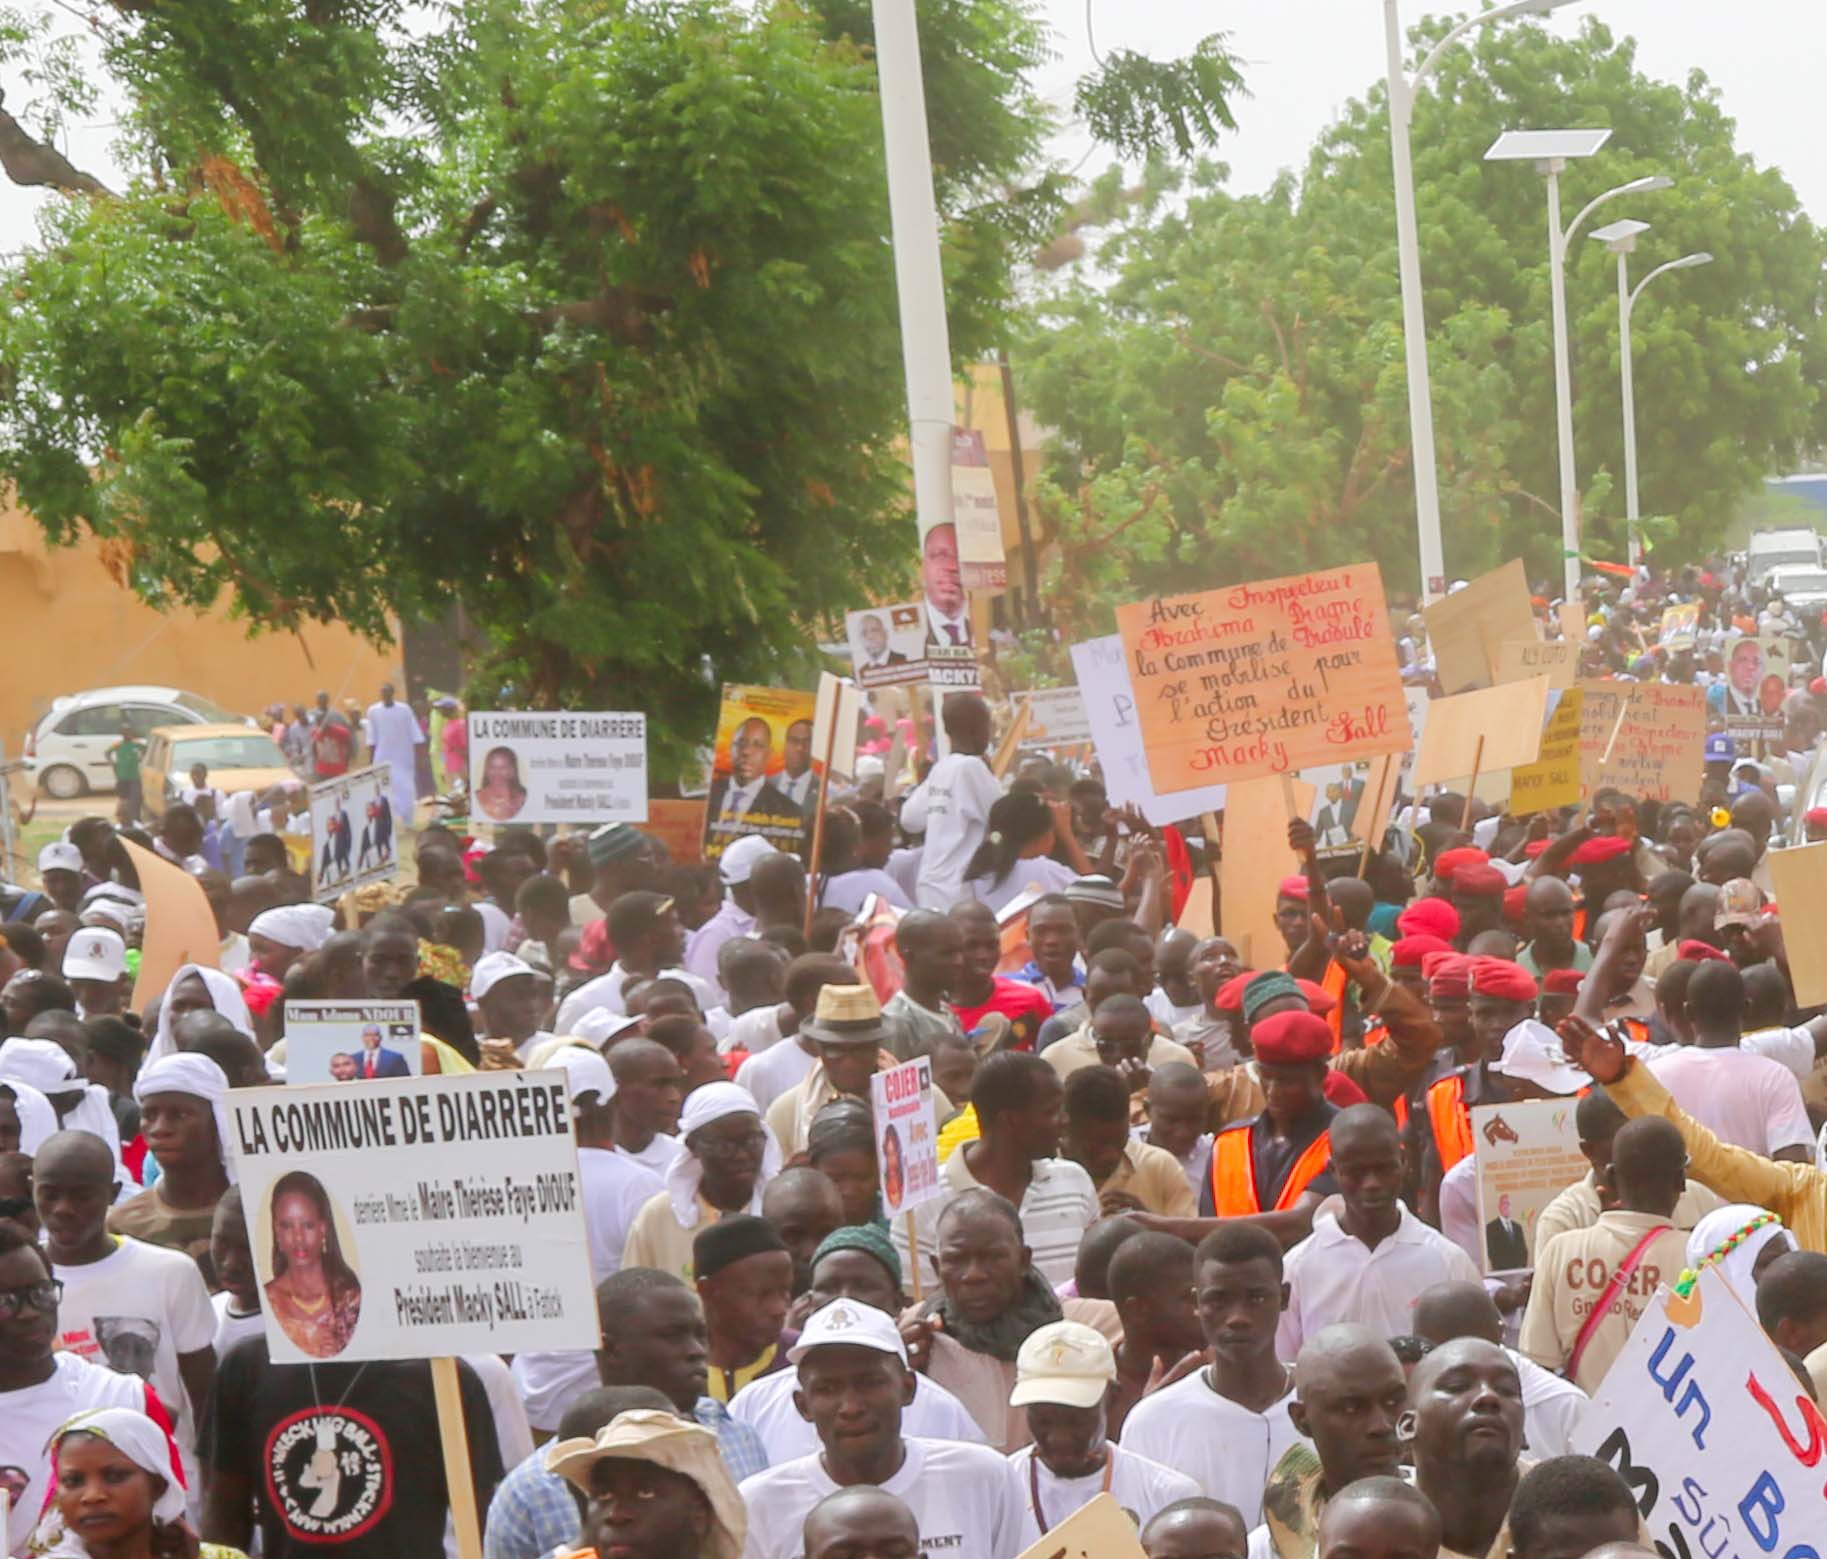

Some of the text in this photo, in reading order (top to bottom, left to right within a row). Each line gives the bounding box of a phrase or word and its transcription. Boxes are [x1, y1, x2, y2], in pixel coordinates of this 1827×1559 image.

[1149, 599, 1205, 627] Avec
[1287, 678, 1317, 703] du
[491, 719, 558, 739] COMMUNE
[884, 1065, 920, 1104] COJER
[234, 1073, 570, 1156] LA COMMUNE DE DIARRÈRE
[416, 1176, 456, 1221] Maire
[504, 1173, 536, 1224] Faye
[535, 1171, 578, 1213] DIOUF
[393, 1282, 529, 1331] Président Macky SALL
